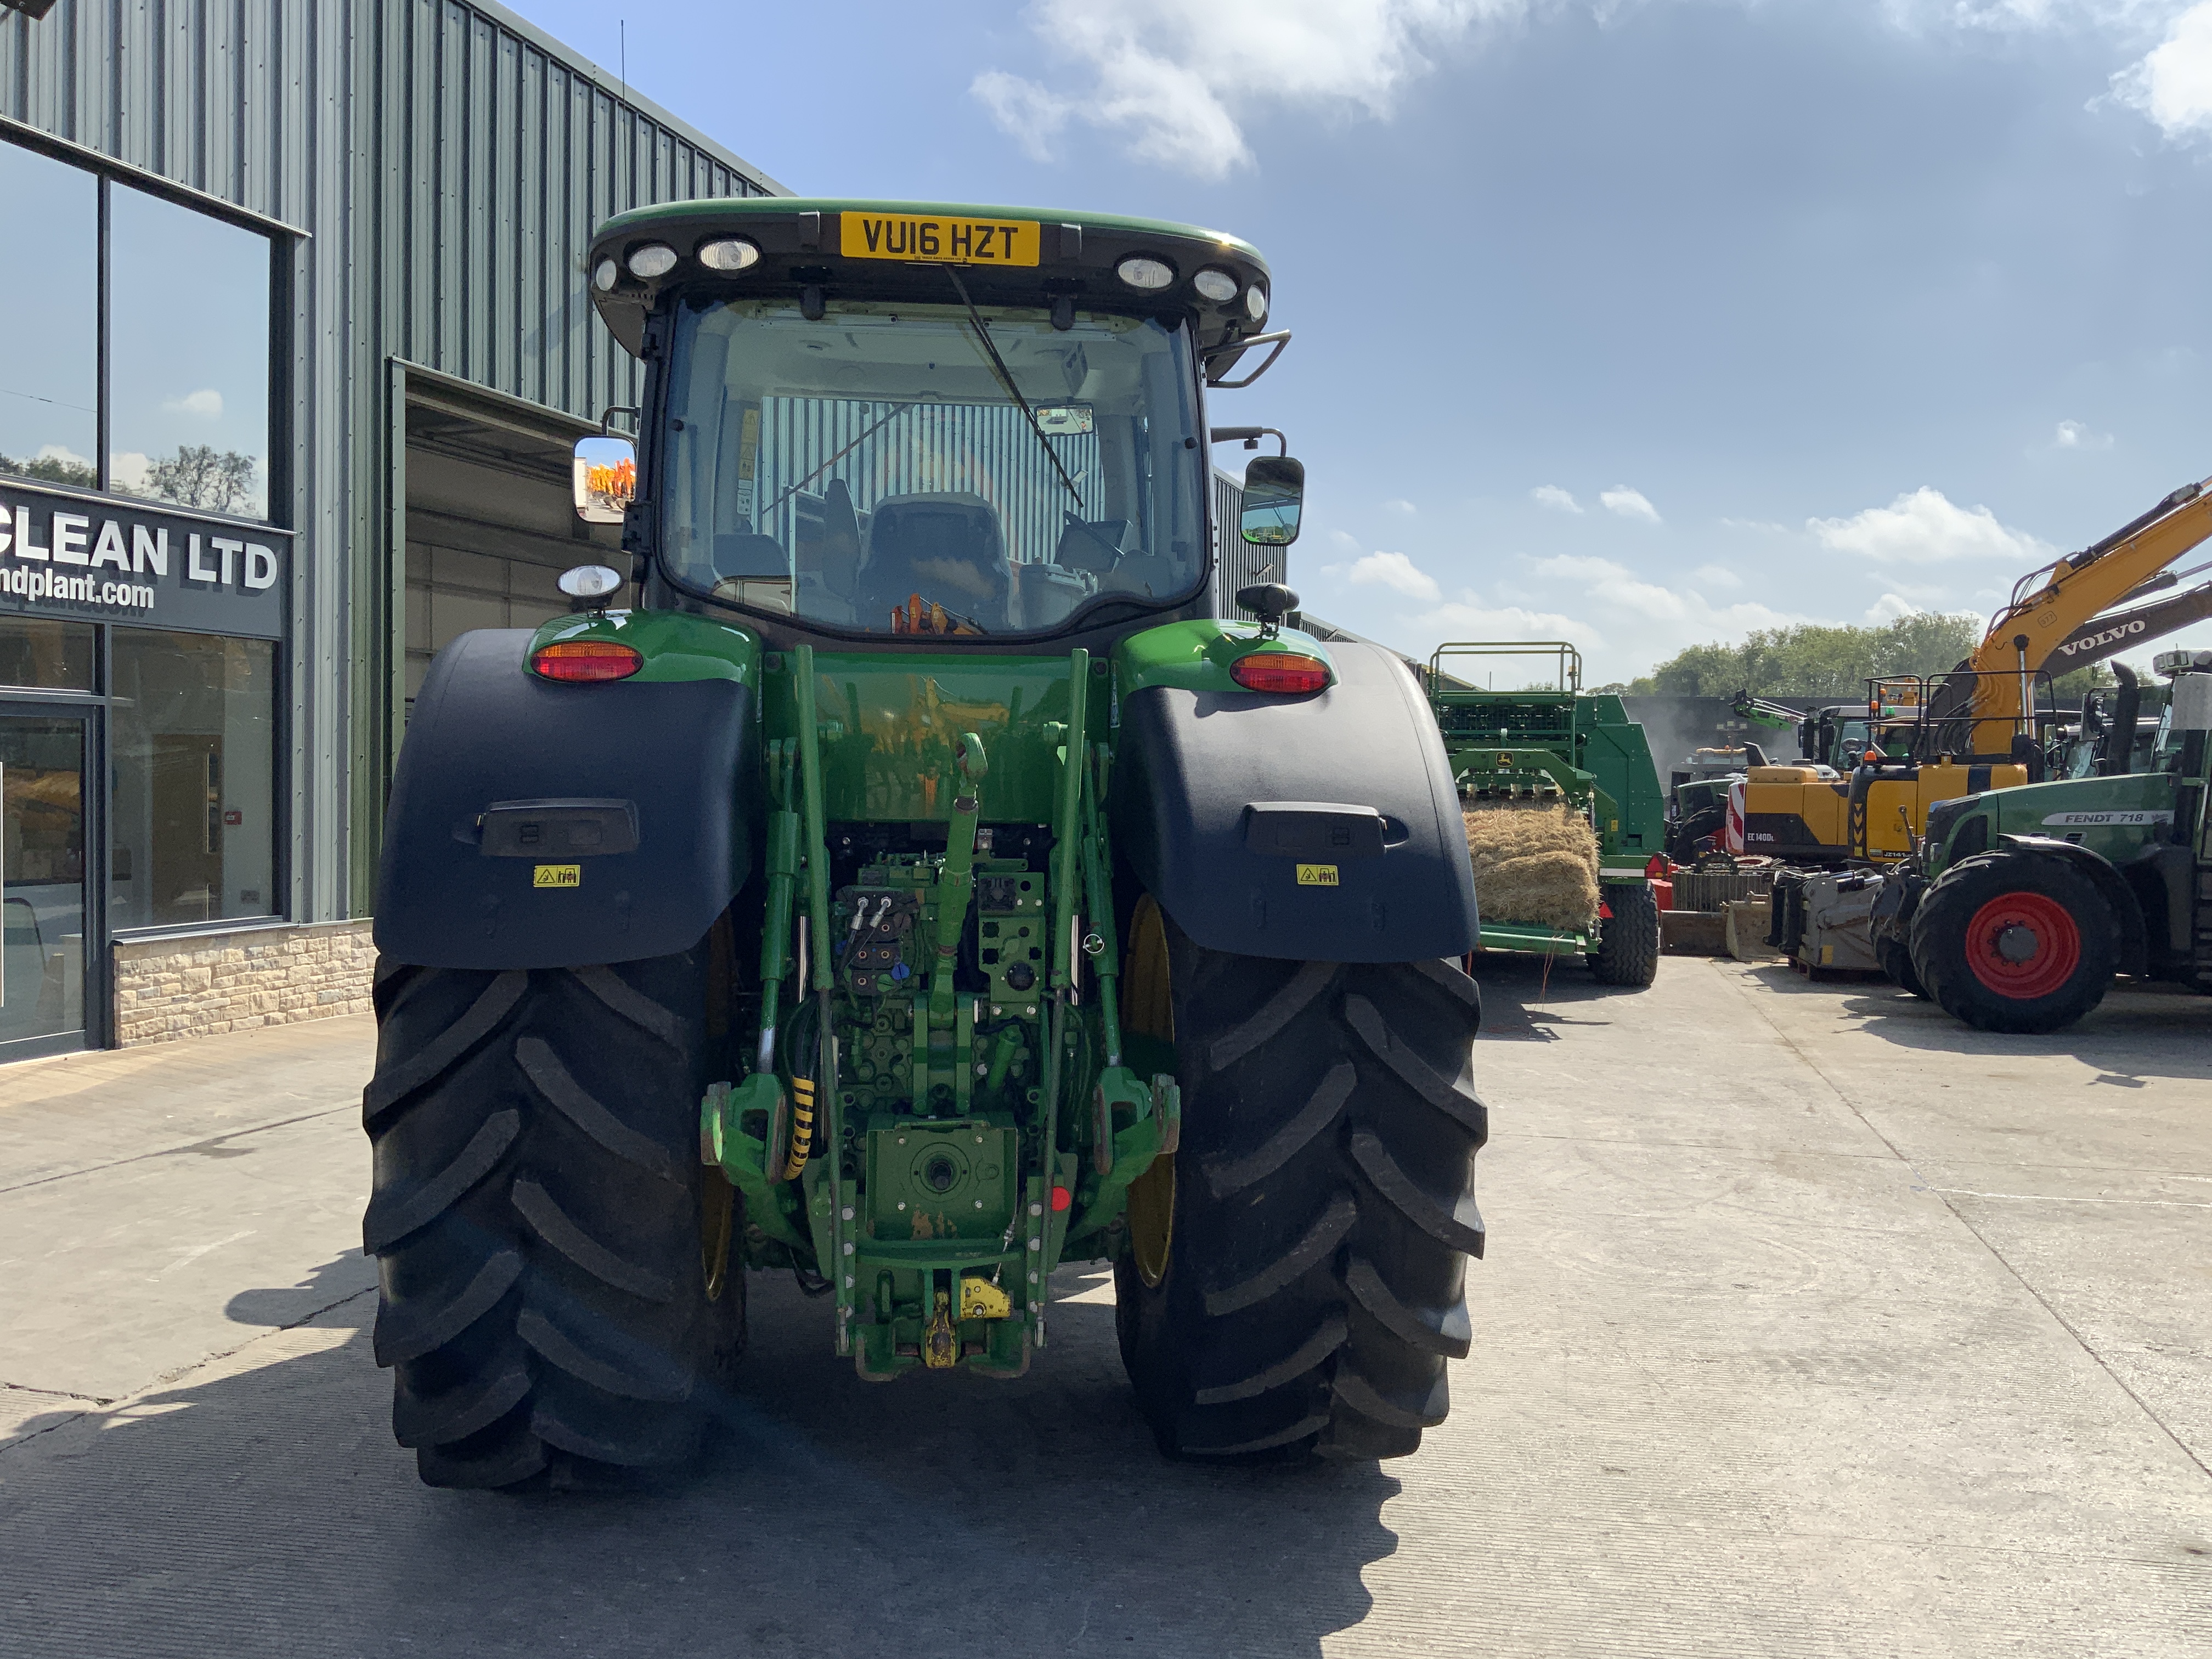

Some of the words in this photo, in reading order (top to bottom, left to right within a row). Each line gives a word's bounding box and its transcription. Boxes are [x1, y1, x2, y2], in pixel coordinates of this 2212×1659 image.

[863, 219, 939, 255] VU16
[951, 224, 1018, 259] HZT
[188, 533, 277, 589] LTD
[0, 565, 154, 609] ndplant.com
[2058, 620, 2146, 656] VOLVO
[2065, 814, 2114, 823] FENDT
[2120, 814, 2144, 822] 718
